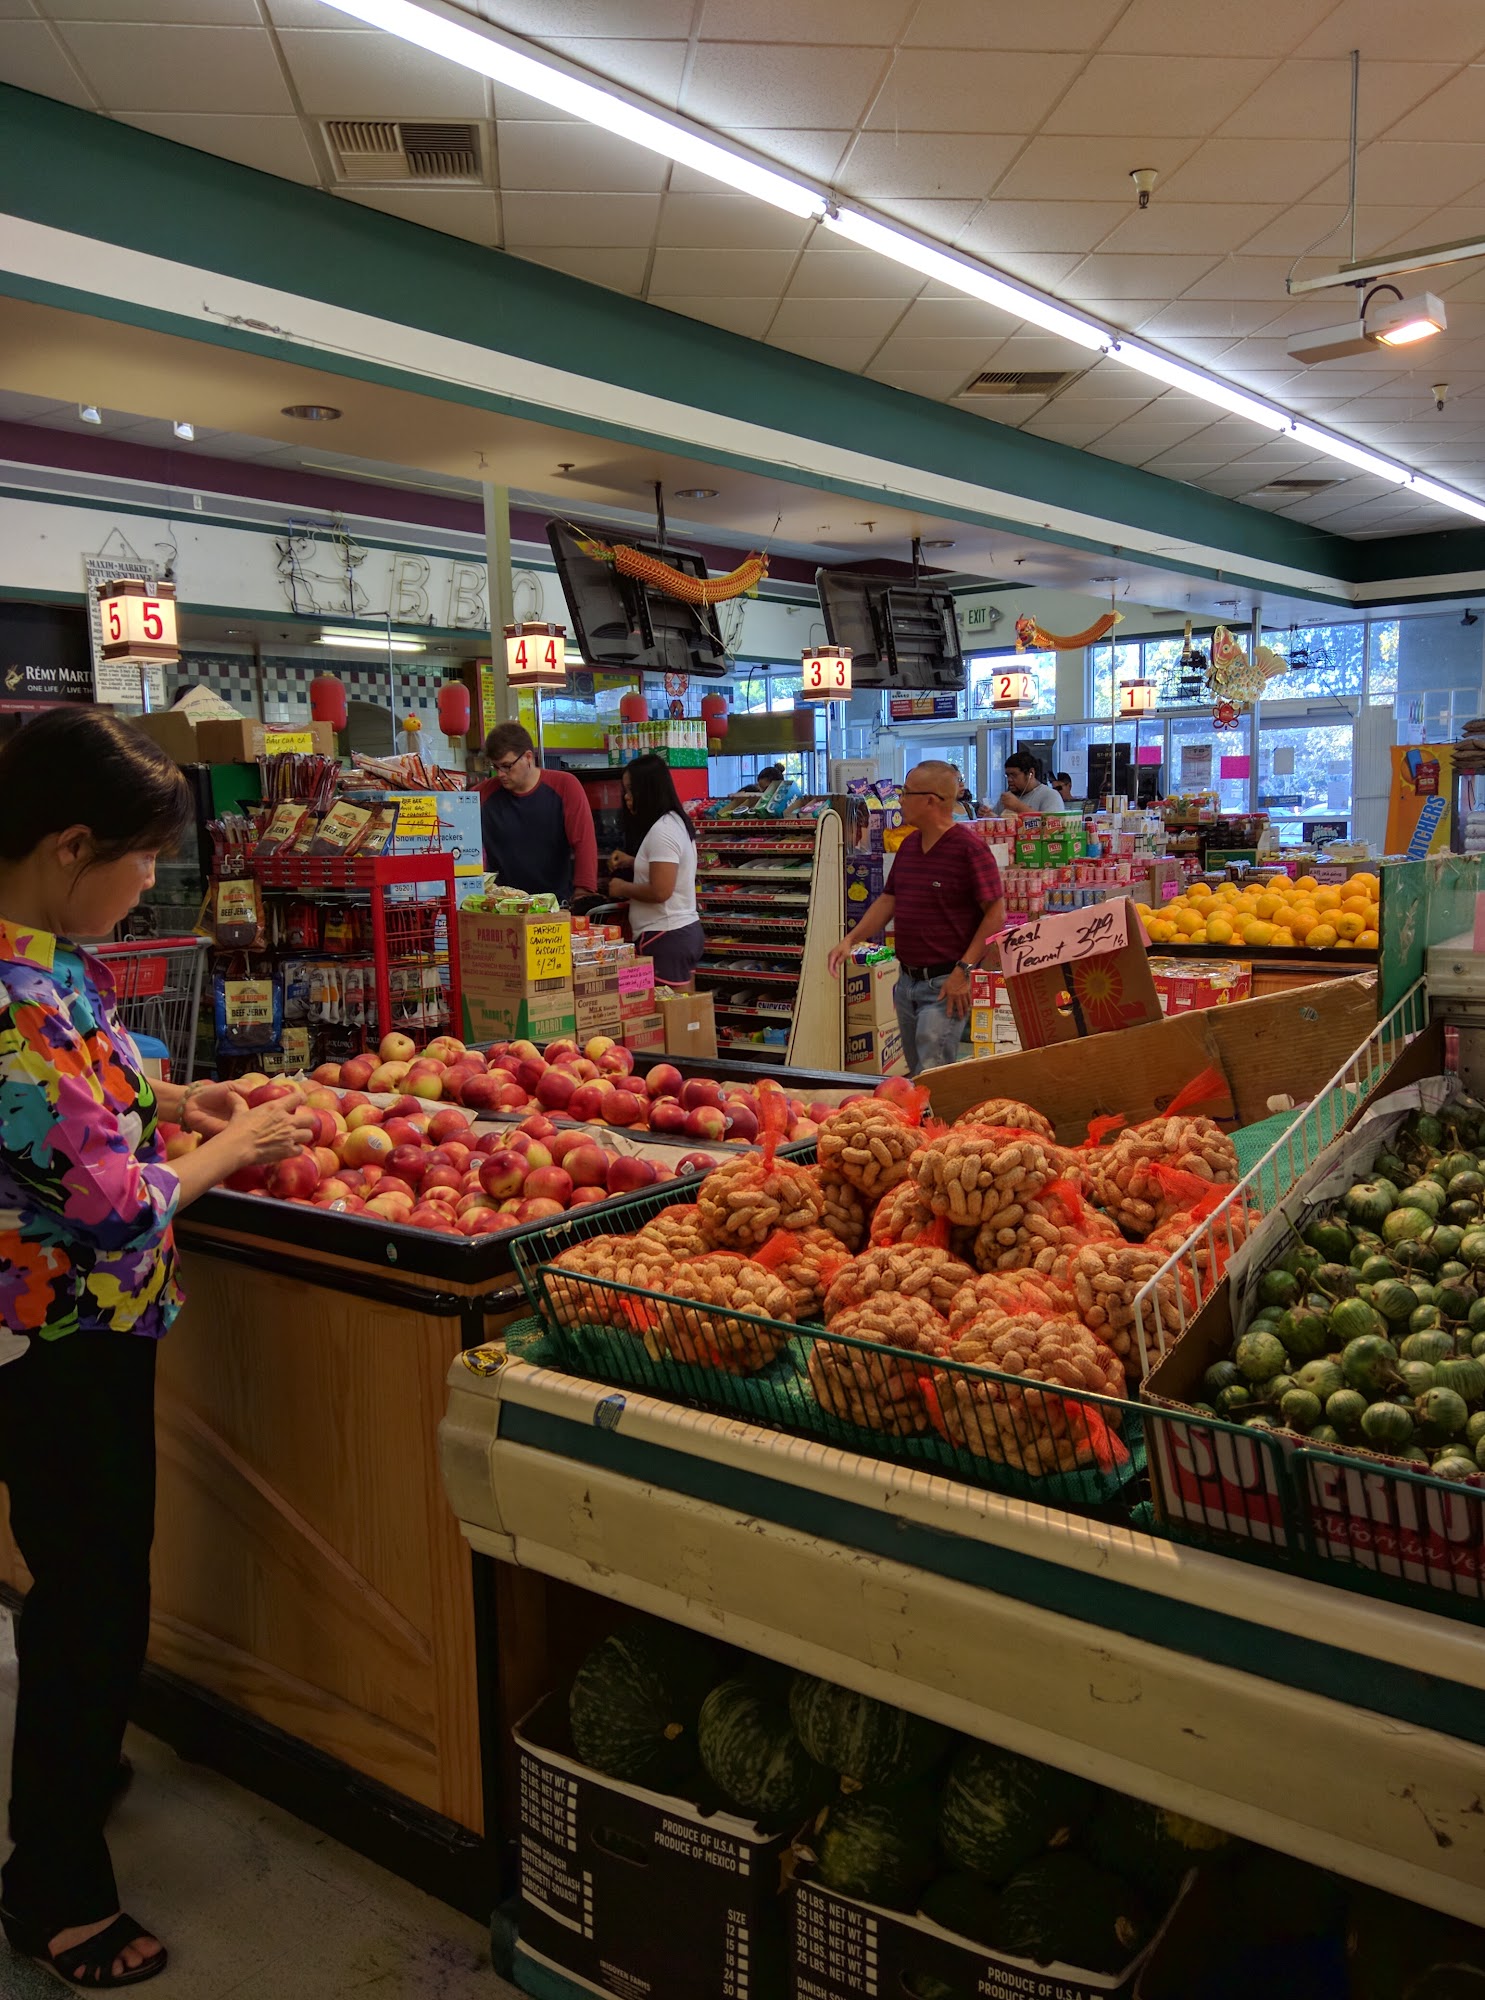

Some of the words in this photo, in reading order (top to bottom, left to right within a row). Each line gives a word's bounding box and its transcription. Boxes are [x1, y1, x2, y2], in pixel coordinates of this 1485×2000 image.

[89, 560, 114, 569] MAXIM
[117, 563, 148, 573] MARKET
[109, 602, 121, 640] 5
[143, 602, 163, 640] 5
[968, 608, 986, 624] EXIT
[515, 640, 528, 669] 4
[544, 640, 557, 669] 4
[25, 665, 57, 680] RÉMY
[58, 667, 91, 682] MART
[811, 661, 822, 686] 3
[836, 661, 845, 686] 3
[27, 684, 42, 692] ONE
[1000, 677, 1011, 698] 2
[1022, 676, 1029, 697] 2
[1127, 689, 1134, 707] 1
[1147, 689, 1152, 707] 1
[323, 825, 337, 835] BEEF
[1406, 794, 1446, 860] ATCHERS
[221, 908, 233, 917] BEEF
[477, 928, 503, 942] PARROT
[530, 935, 562, 945] SANDWICH
[533, 924, 562, 935] PARROT
[535, 944, 565, 955] BISCUITS
[1012, 941, 1067, 973] Peanut
[584, 980, 606, 994] PARROT
[232, 1009, 245, 1017] BEEF
[246, 1008, 268, 1017] JERKY
[578, 1000, 598, 1009] COFFEE
[535, 1018, 562, 1034] PARROT
[1311, 1515, 1443, 1561] alifornia
[521, 1754, 528, 1769] 40
[529, 1759, 540, 1776] LBS.
[541, 1768, 554, 1784] NET
[554, 1774, 567, 1791] WT.
[529, 1773, 540, 1790] LBS.
[541, 1782, 553, 1799] NET
[553, 1790, 566, 1806] WT.
[529, 1787, 540, 1803] LBS.
[541, 1796, 553, 1812] NET
[553, 1804, 566, 1820] WT.
[521, 1809, 528, 1823] 25
[529, 1815, 540, 1833] LBS.
[541, 1824, 553, 1840] NET
[553, 1832, 566, 1848] WT.
[529, 1801, 540, 1819] LBS.
[541, 1810, 553, 1826] NET
[553, 1818, 566, 1834] WT.
[662, 1818, 700, 1843] PRODUCE
[700, 1833, 712, 1847] OF
[713, 1837, 736, 1856] U.S.A.
[542, 1848, 567, 1872] SQUASH
[654, 1831, 691, 1856] PRODUCE
[692, 1846, 703, 1860] OF
[705, 1850, 737, 1871] MEXICO
[521, 1847, 554, 1878] BUTTERNUT
[554, 1869, 581, 1893] SQUASH
[521, 1873, 548, 1900] KABOCHA
[551, 1881, 578, 1905] SQUASH
[727, 1909, 747, 1925] SIZE
[796, 1888, 807, 1903] 40
[809, 1893, 827, 1912] LBS.
[829, 1902, 846, 1920] NET
[847, 1910, 864, 1928] WT.
[726, 1923, 735, 1937] 12
[796, 1902, 807, 1918] 35
[809, 1908, 827, 1928] LBS.
[829, 1918, 846, 1936] NET
[847, 1925, 864, 1944] WT.
[725, 1938, 735, 1952] 15
[796, 1918, 807, 1934] 32
[809, 1924, 827, 1943] LBS.
[829, 1934, 845, 1952] NET
[847, 1941, 863, 1960] WT.
[725, 1953, 735, 1967] 18
[796, 1934, 808, 1949] 30
[809, 1940, 827, 1960] LBS.
[829, 1949, 845, 1968] NET
[847, 1958, 863, 1976] WT.
[723, 1968, 734, 1981] 24
[797, 1949, 808, 1965] 25
[809, 1955, 827, 1975] LBS.
[829, 1965, 845, 1984] NET
[847, 1973, 864, 1991] WT.
[987, 1966, 1036, 1994] PRODUCE
[1038, 1983, 1053, 1997] OF
[630, 1974, 652, 1992] FARMS
[722, 1982, 734, 1996] 30
[797, 1976, 827, 2000] DANISH
